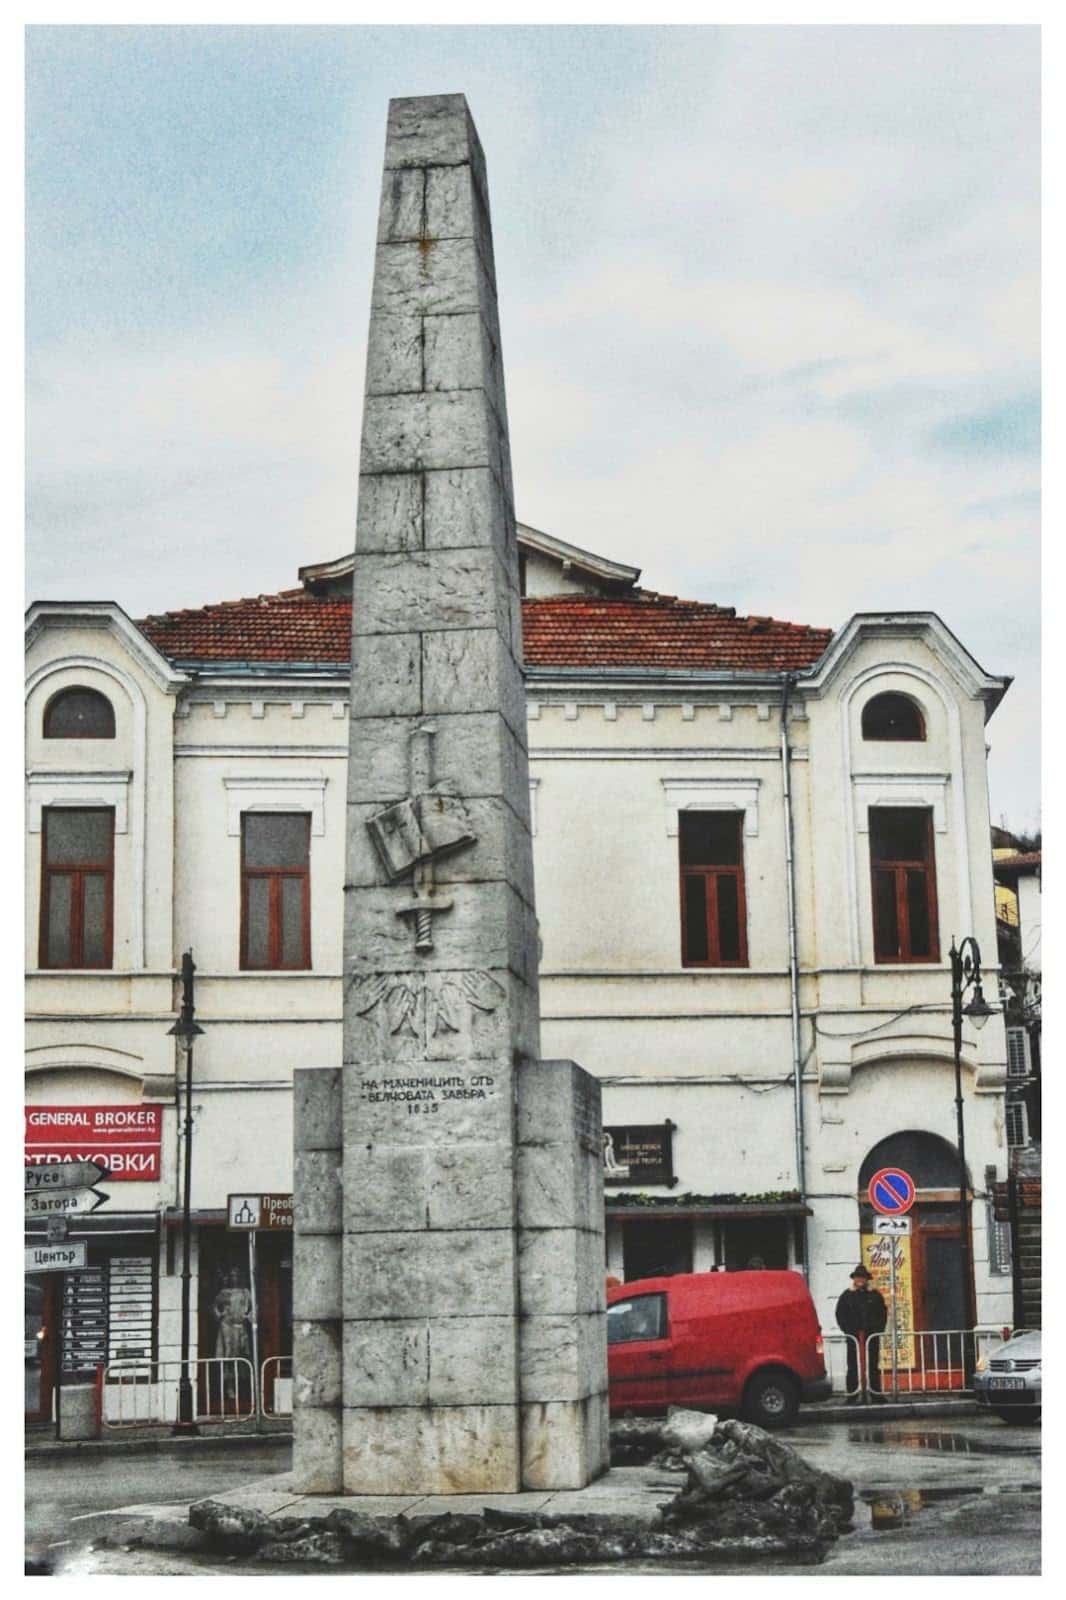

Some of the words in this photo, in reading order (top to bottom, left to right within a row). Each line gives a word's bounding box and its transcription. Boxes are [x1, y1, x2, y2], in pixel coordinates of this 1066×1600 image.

[29, 1112, 91, 1126] GENERAL
[95, 1111, 156, 1126] BROKER
[26, 1171, 59, 1186] Русе
[31, 1198, 78, 1211] Загора
[34, 1250, 76, 1264] Център
